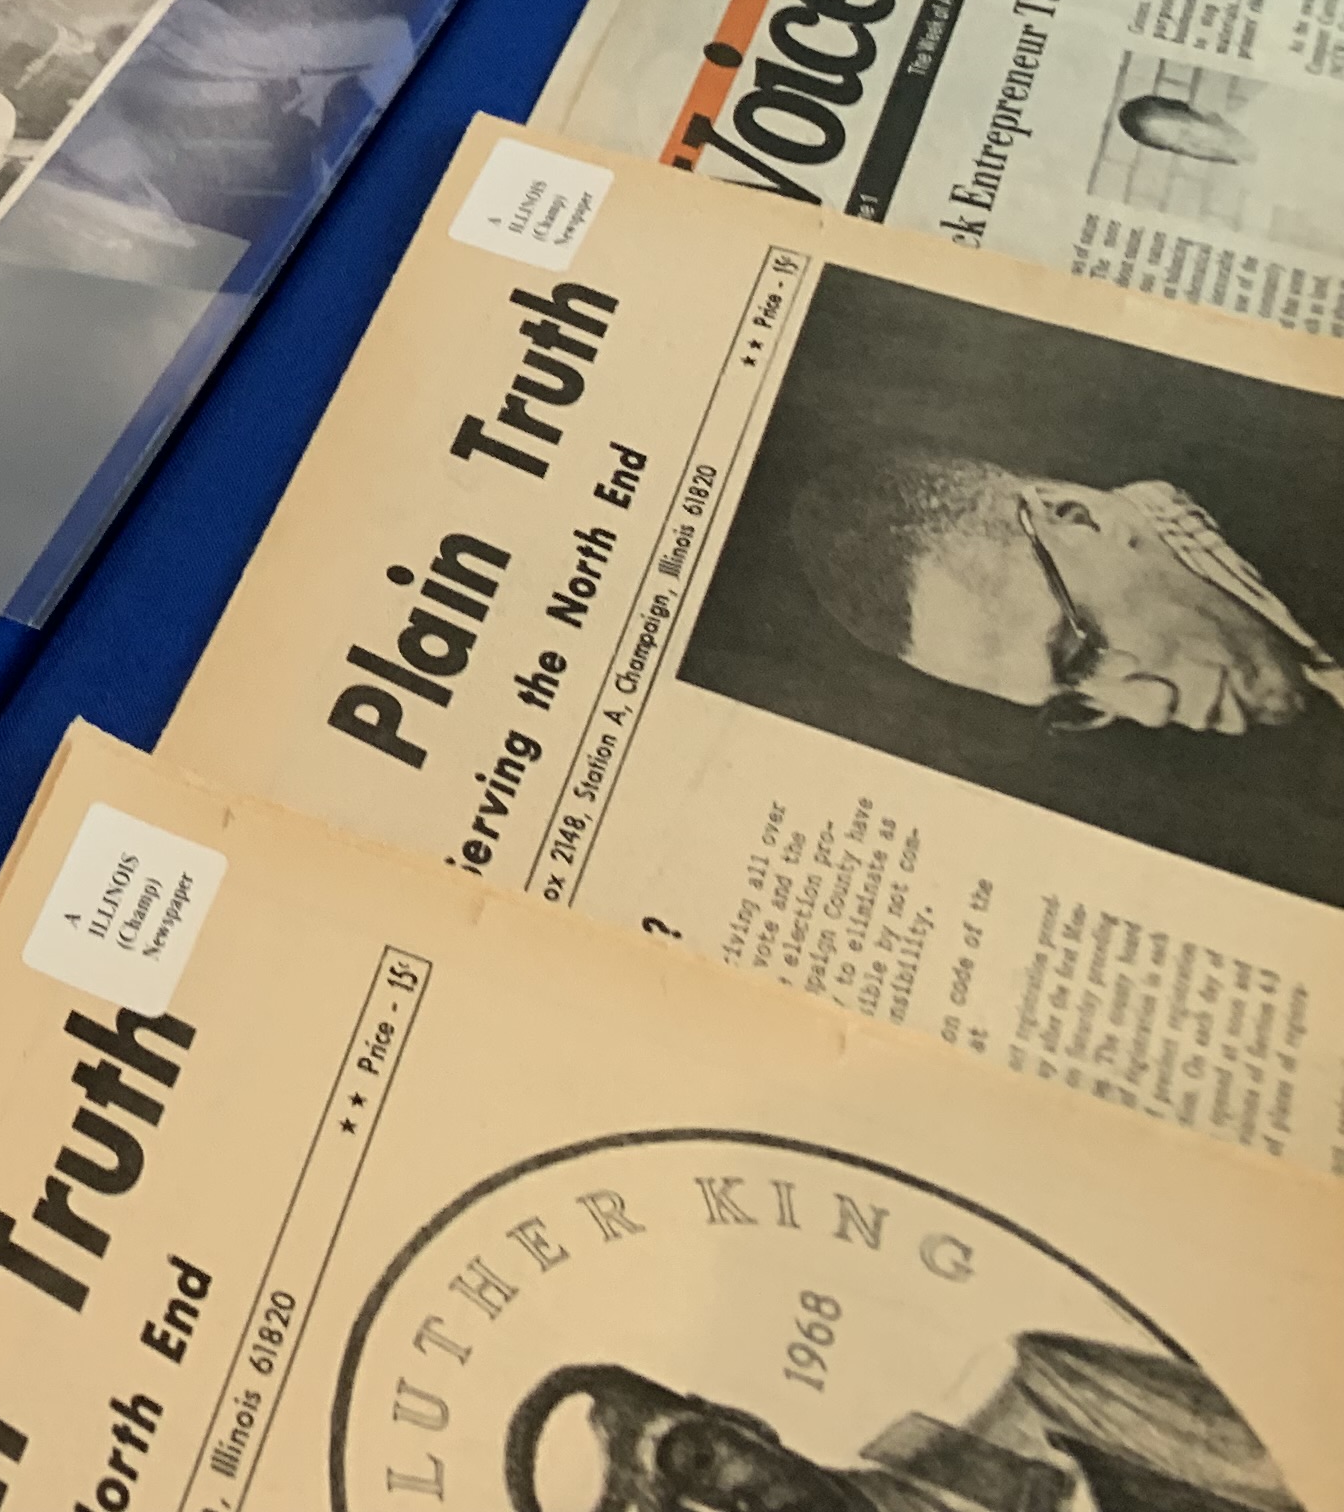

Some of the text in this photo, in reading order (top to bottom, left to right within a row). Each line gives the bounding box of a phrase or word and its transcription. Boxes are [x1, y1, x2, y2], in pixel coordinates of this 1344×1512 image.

[949, 26, 1051, 217] Entrepreneur
[486, 215, 503, 230] A
[508, 179, 548, 236] ILLINOIS
[532, 192, 569, 245] (Champ)
[553, 190, 594, 247] Newspaper
[752, 293, 784, 333] Price
[327, 281, 620, 771] Plain Truth
[681, 464, 719, 517] 61820
[513, 649, 568, 712] the
[545, 525, 618, 630] North
[593, 441, 649, 510] End
[657, 524, 696, 581] Illinois
[613, 588, 680, 694] Champaign,
[614, 703, 636, 728] A,
[573, 733, 616, 803] Station
[549, 814, 595, 866] 2148,
[747, 852, 771, 892] all
[761, 799, 788, 849] over
[64, 911, 82, 930] A
[87, 850, 141, 940] ILLINOIS
[116, 876, 164, 952] (Champ)
[141, 870, 195, 963] Newspaper
[751, 830, 807, 969] vote and the
[783, 873, 823, 969] election
[823, 848, 863, 922] County
[886, 879, 910, 920] not
[834, 961, 857, 988] to
[873, 923, 902, 956] by
[209, 1388, 264, 1480] Illinois
[248, 1289, 297, 1376] 61820
[356, 1020, 396, 1077] Price
[386, 1174, 976, 1503] LUTHER KING
[782, 1288, 844, 1395] 1968
[74, 1253, 214, 1512] orth End
